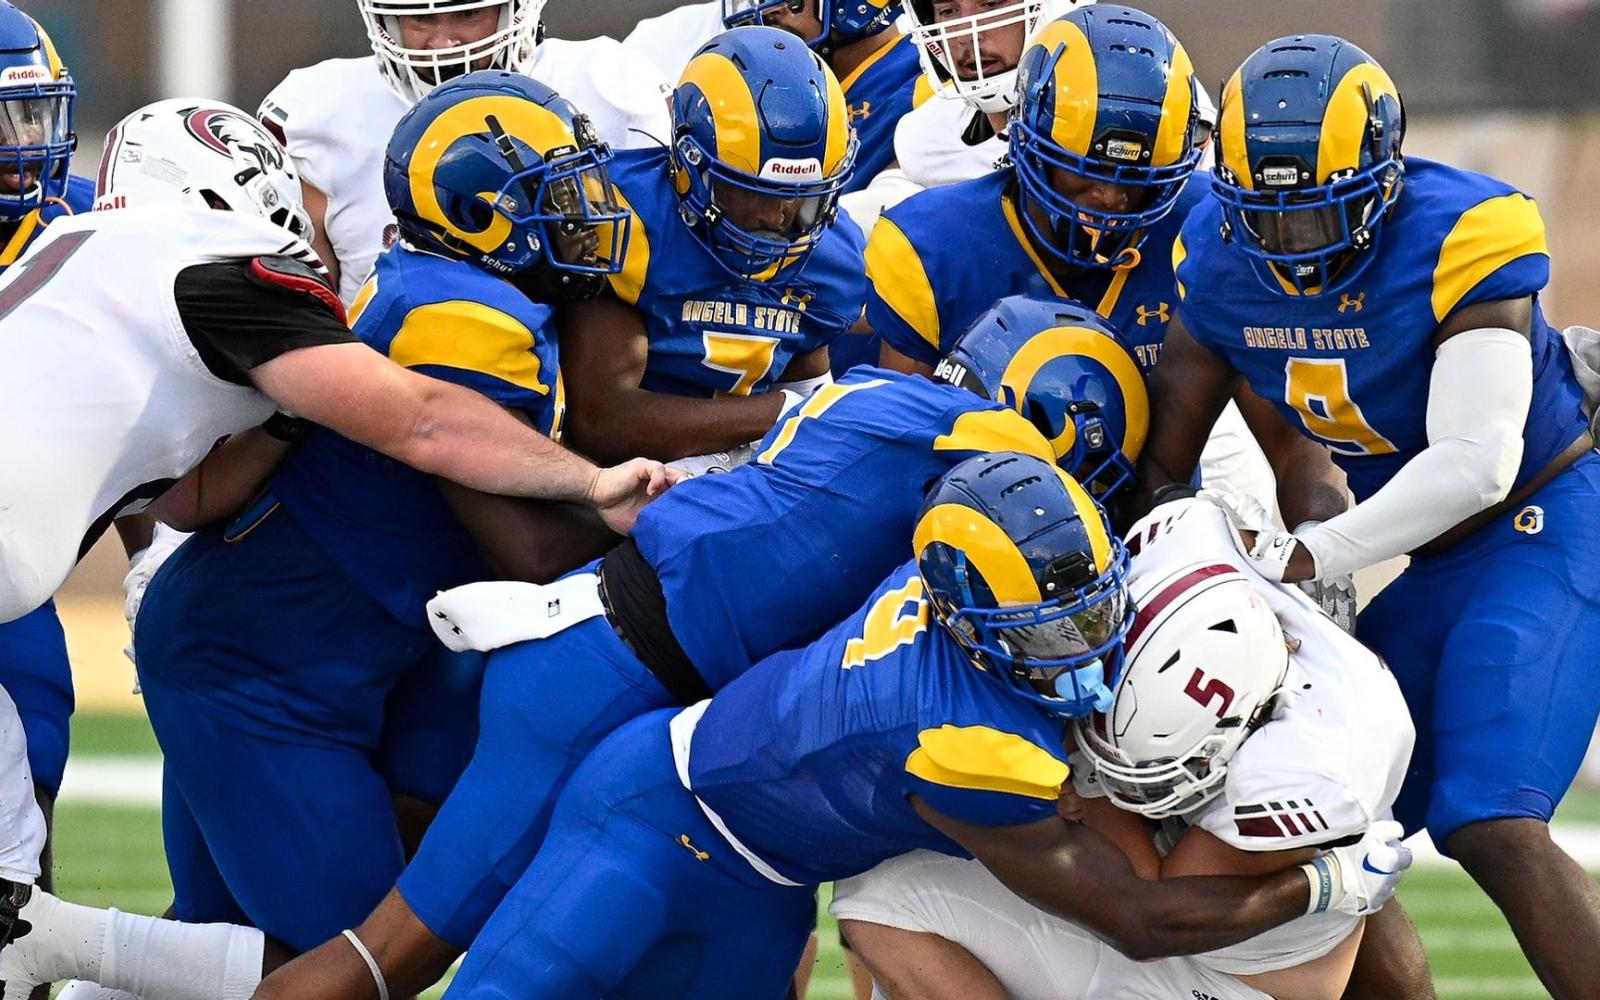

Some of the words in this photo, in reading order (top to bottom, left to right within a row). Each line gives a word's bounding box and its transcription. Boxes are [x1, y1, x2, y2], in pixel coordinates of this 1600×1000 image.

[771, 162, 816, 174] Riddell
[1265, 171, 1297, 181] schutt
[480, 254, 513, 272] schu
[682, 300, 748, 326] ANGELO
[754, 306, 802, 334] STATE
[1243, 326, 1308, 350] ANGELO
[1312, 327, 1371, 350] STATE
[700, 330, 781, 397] 7
[1183, 666, 1236, 720] 5
